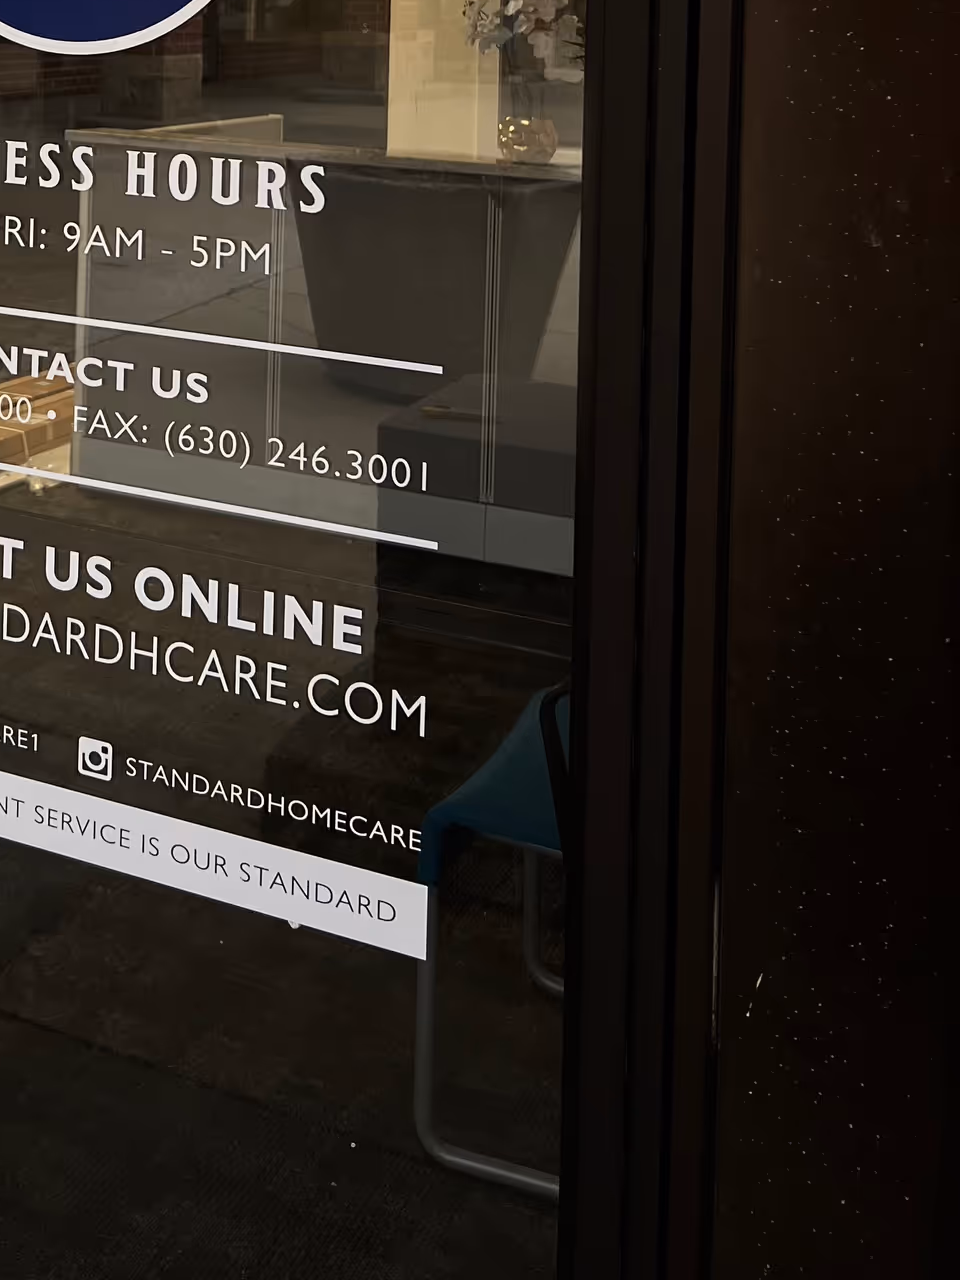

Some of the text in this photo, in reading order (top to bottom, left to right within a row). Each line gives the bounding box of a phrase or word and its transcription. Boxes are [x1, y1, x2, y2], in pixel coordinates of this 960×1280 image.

[125, 150, 325, 214] HOURS
[63, 222, 145, 261] 9AM
[190, 235, 271, 275] 5PM
[152, 366, 208, 403] US
[73, 405, 149, 444] FAX:
[165, 421, 250, 469] (630)
[267, 437, 427, 491] 246.3001
[45, 546, 112, 599] US
[134, 567, 362, 654] ONLINE
[125, 757, 422, 852] STANDARDHOMECARE
[34, 805, 130, 850] SERVICE
[142, 834, 160, 857] IS
[171, 844, 228, 877] OUR
[239, 862, 396, 922] STANDARD
